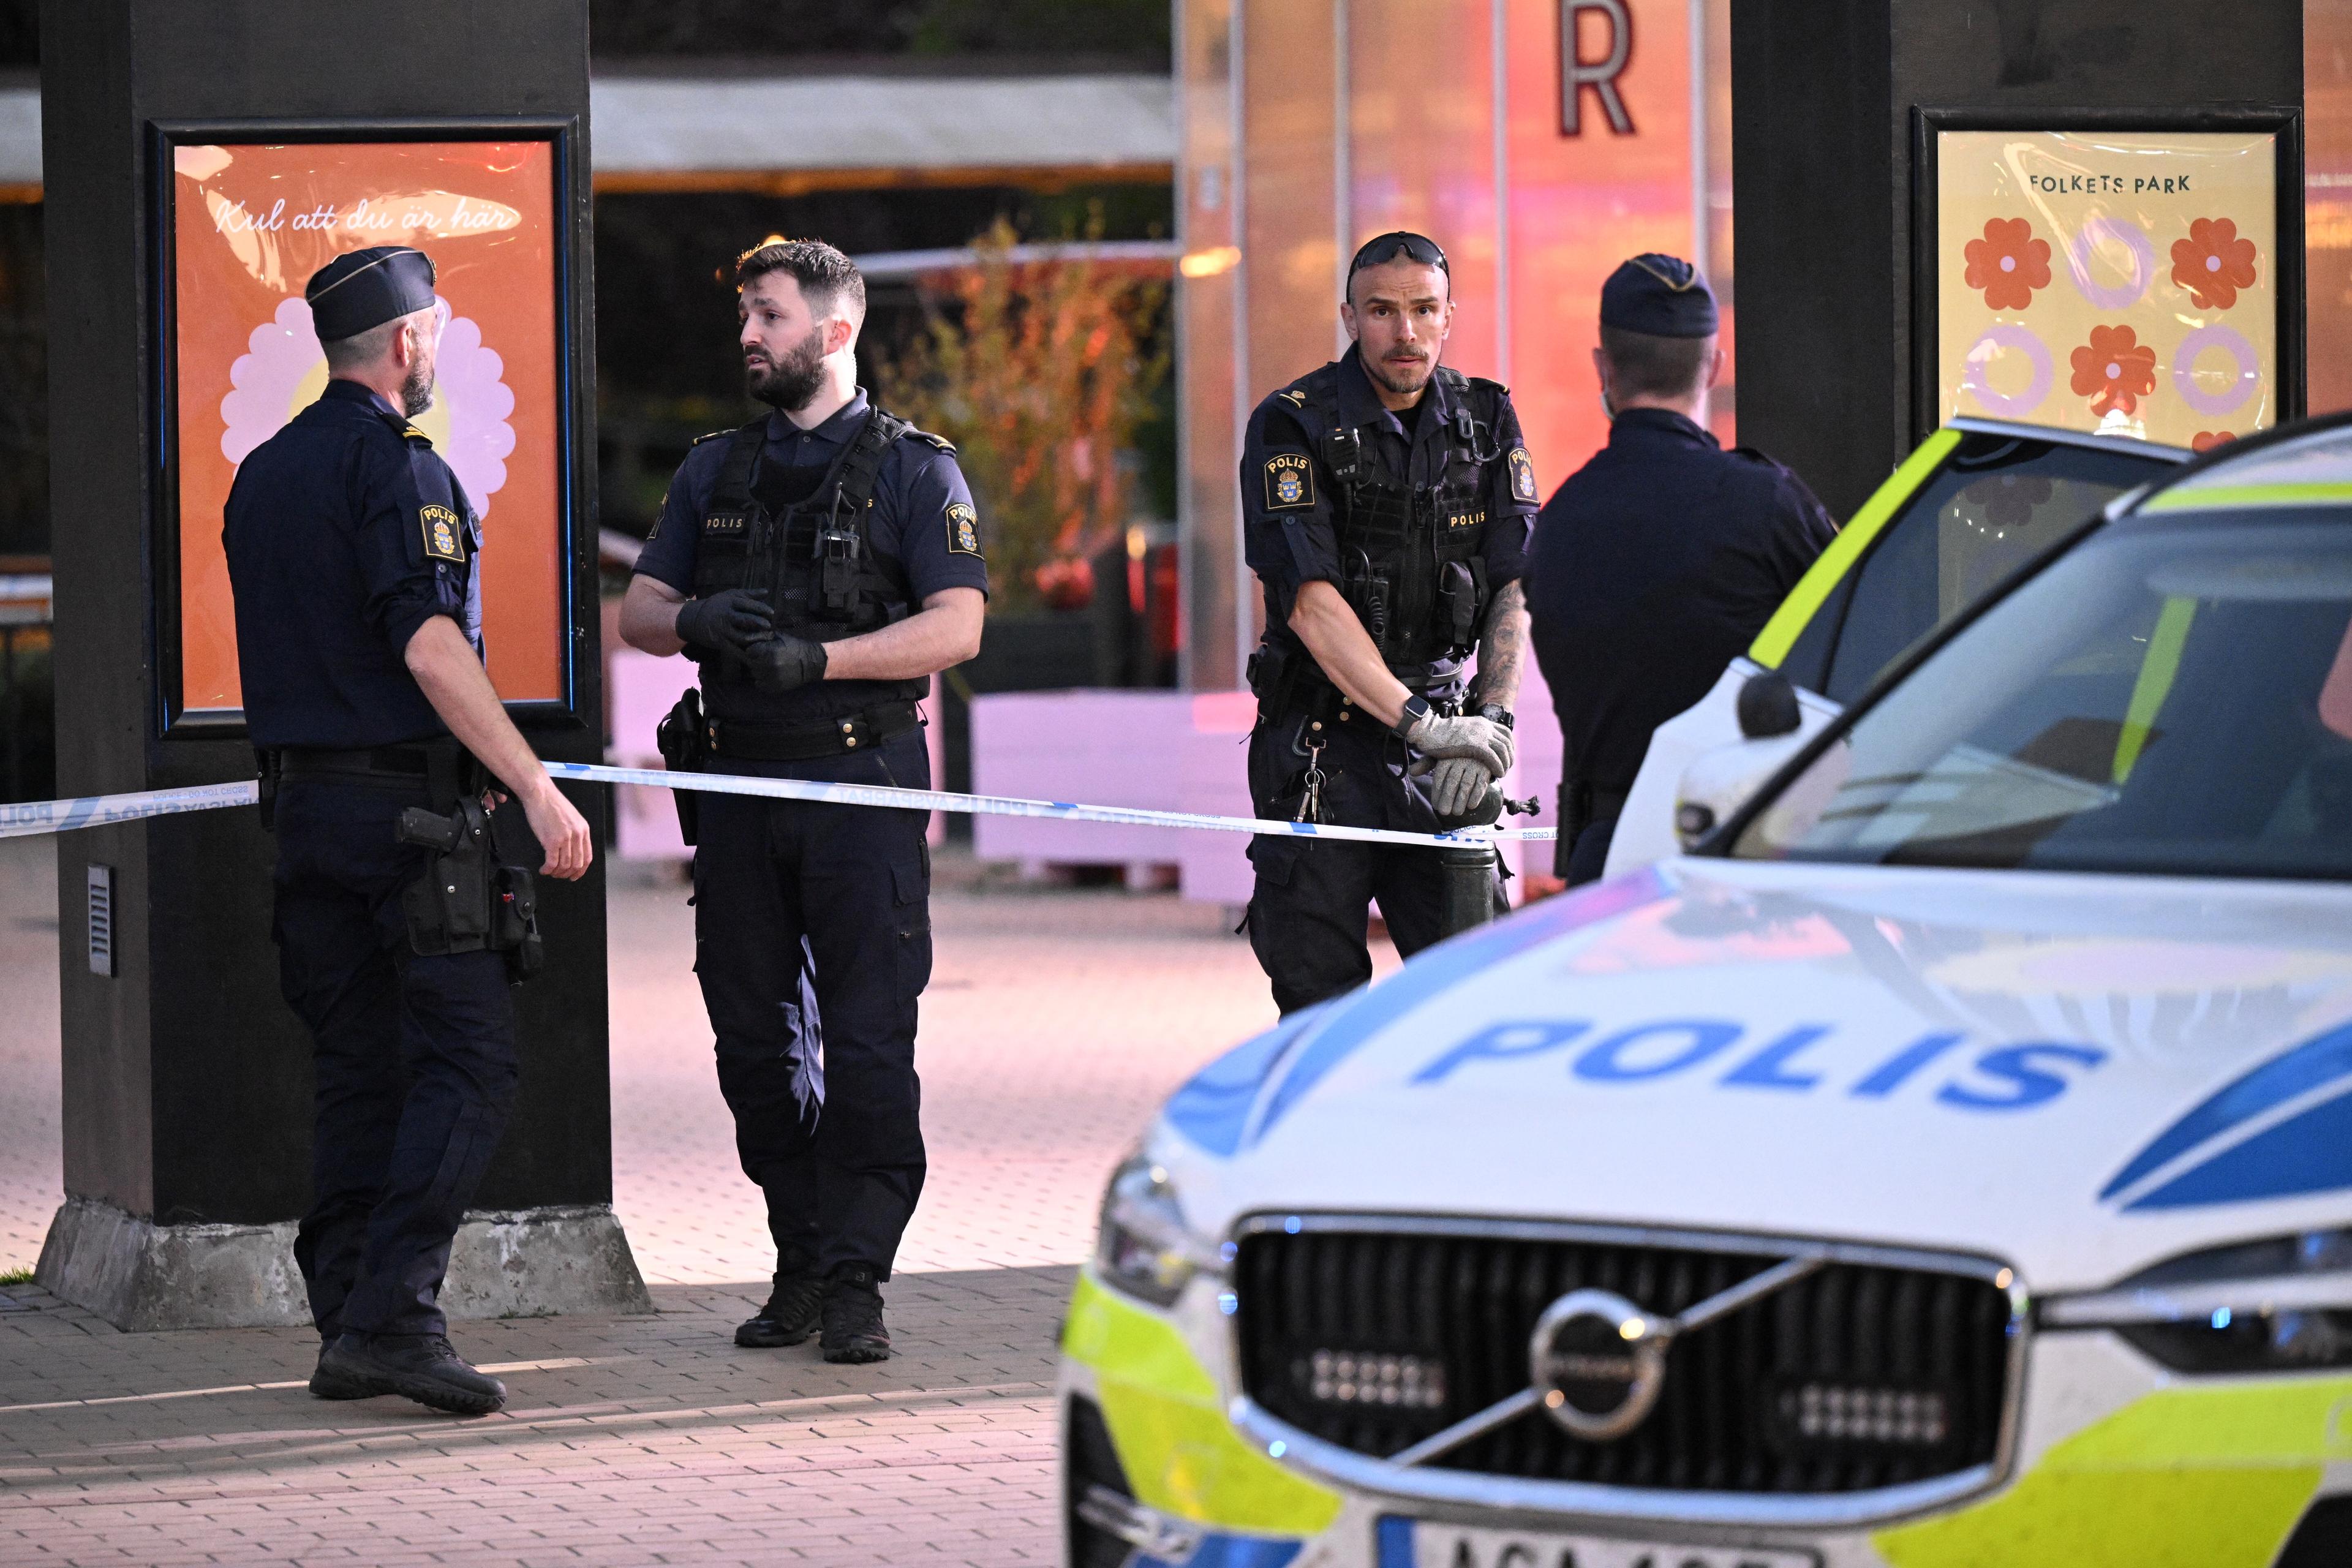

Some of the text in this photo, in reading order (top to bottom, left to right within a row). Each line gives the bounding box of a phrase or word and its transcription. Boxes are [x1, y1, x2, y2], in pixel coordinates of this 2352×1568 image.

[1558, 0, 1635, 134] R
[2030, 175, 2190, 194] FOLKETS PARK
[216, 197, 513, 233] Kul att du är här
[1268, 457, 1308, 473] POLIS
[424, 508, 455, 524] POLIS
[706, 518, 744, 529] POLIS
[1450, 511, 1485, 527] POLIS
[1406, 1019, 2110, 1113] POLIS
